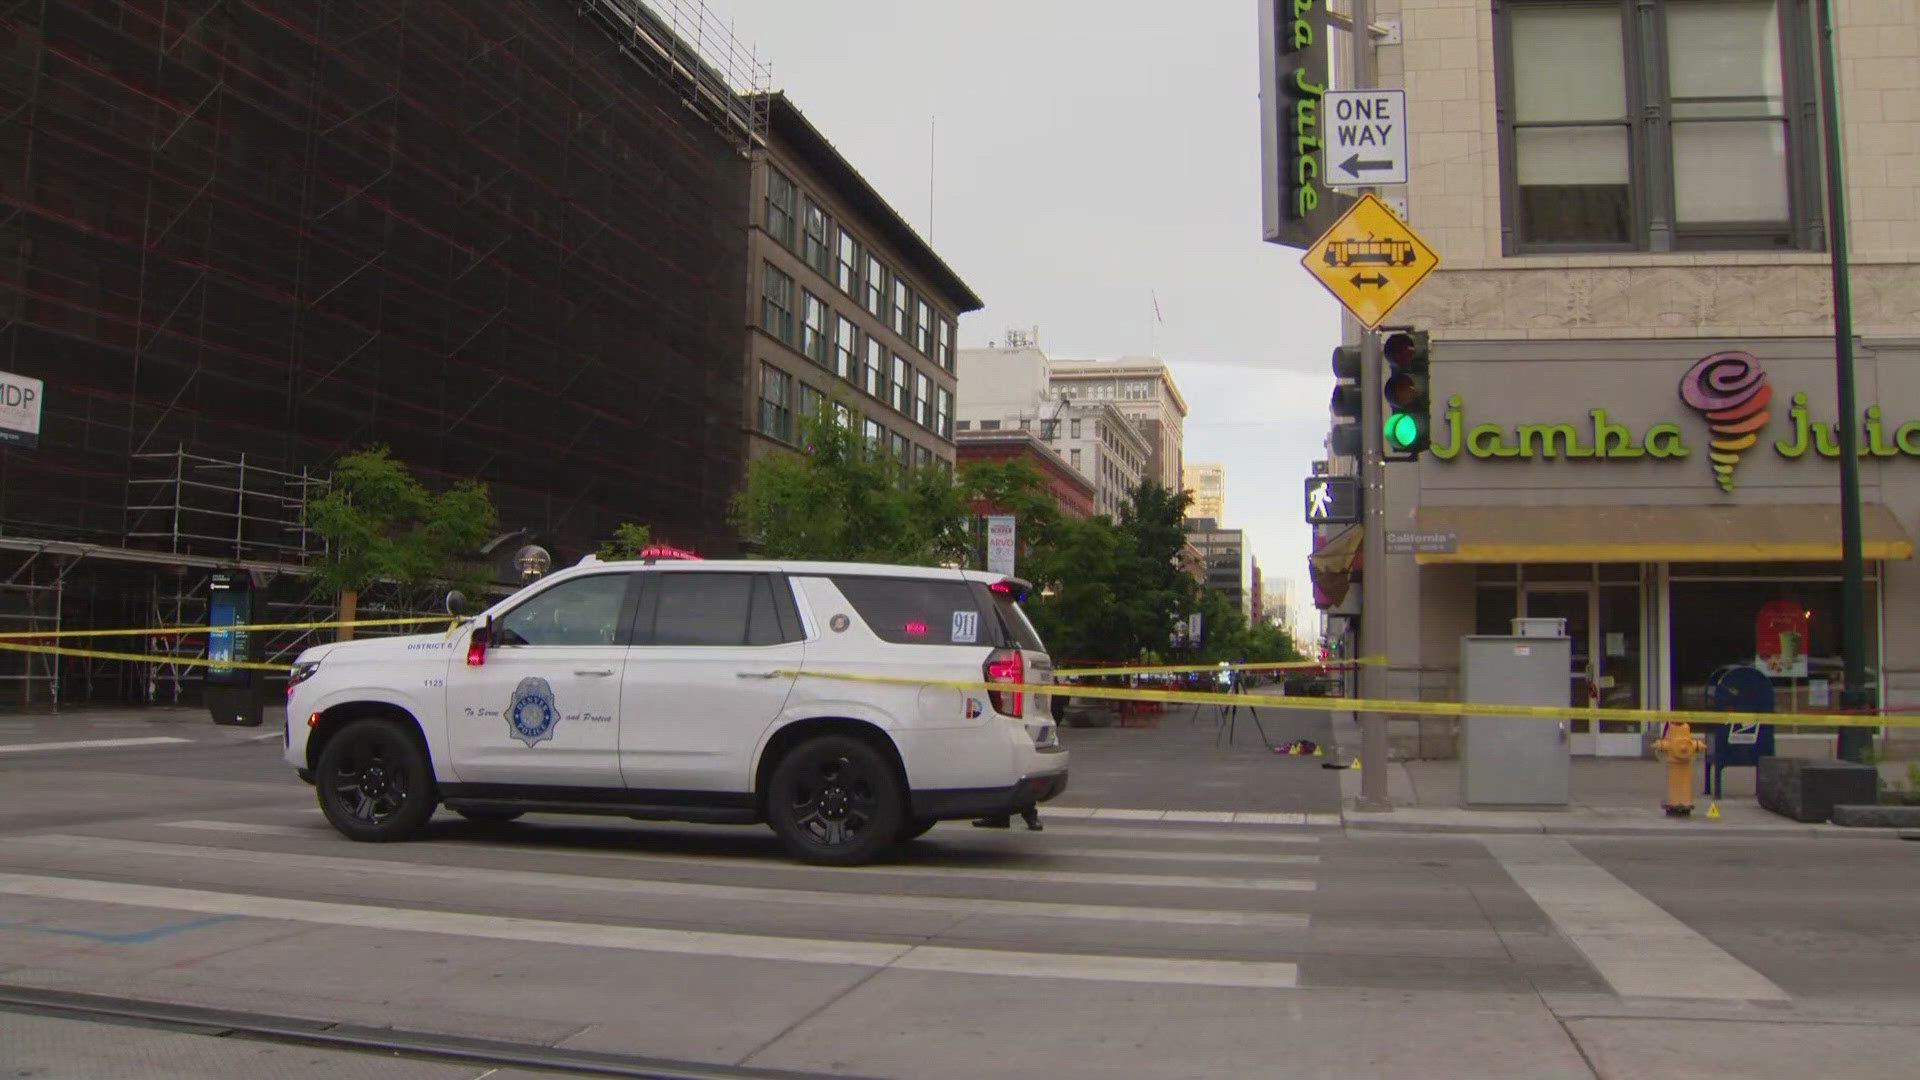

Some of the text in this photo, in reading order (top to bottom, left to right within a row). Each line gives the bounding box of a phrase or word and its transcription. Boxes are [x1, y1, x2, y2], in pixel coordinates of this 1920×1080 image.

[1336, 98, 1390, 120] ONE
[1338, 124, 1393, 146] WAY
[1430, 394, 1690, 459] jamba
[990, 538, 1013, 547] ARVO
[1387, 533, 1447, 543] California
[954, 613, 975, 635] 911
[407, 642, 445, 650] DISTRICT
[424, 679, 443, 687] 1125
[515, 696, 548, 711] DENVER
[464, 707, 499, 717] To Serve
[565, 712, 611, 722] and Protect
[516, 722, 548, 736] POLICE
